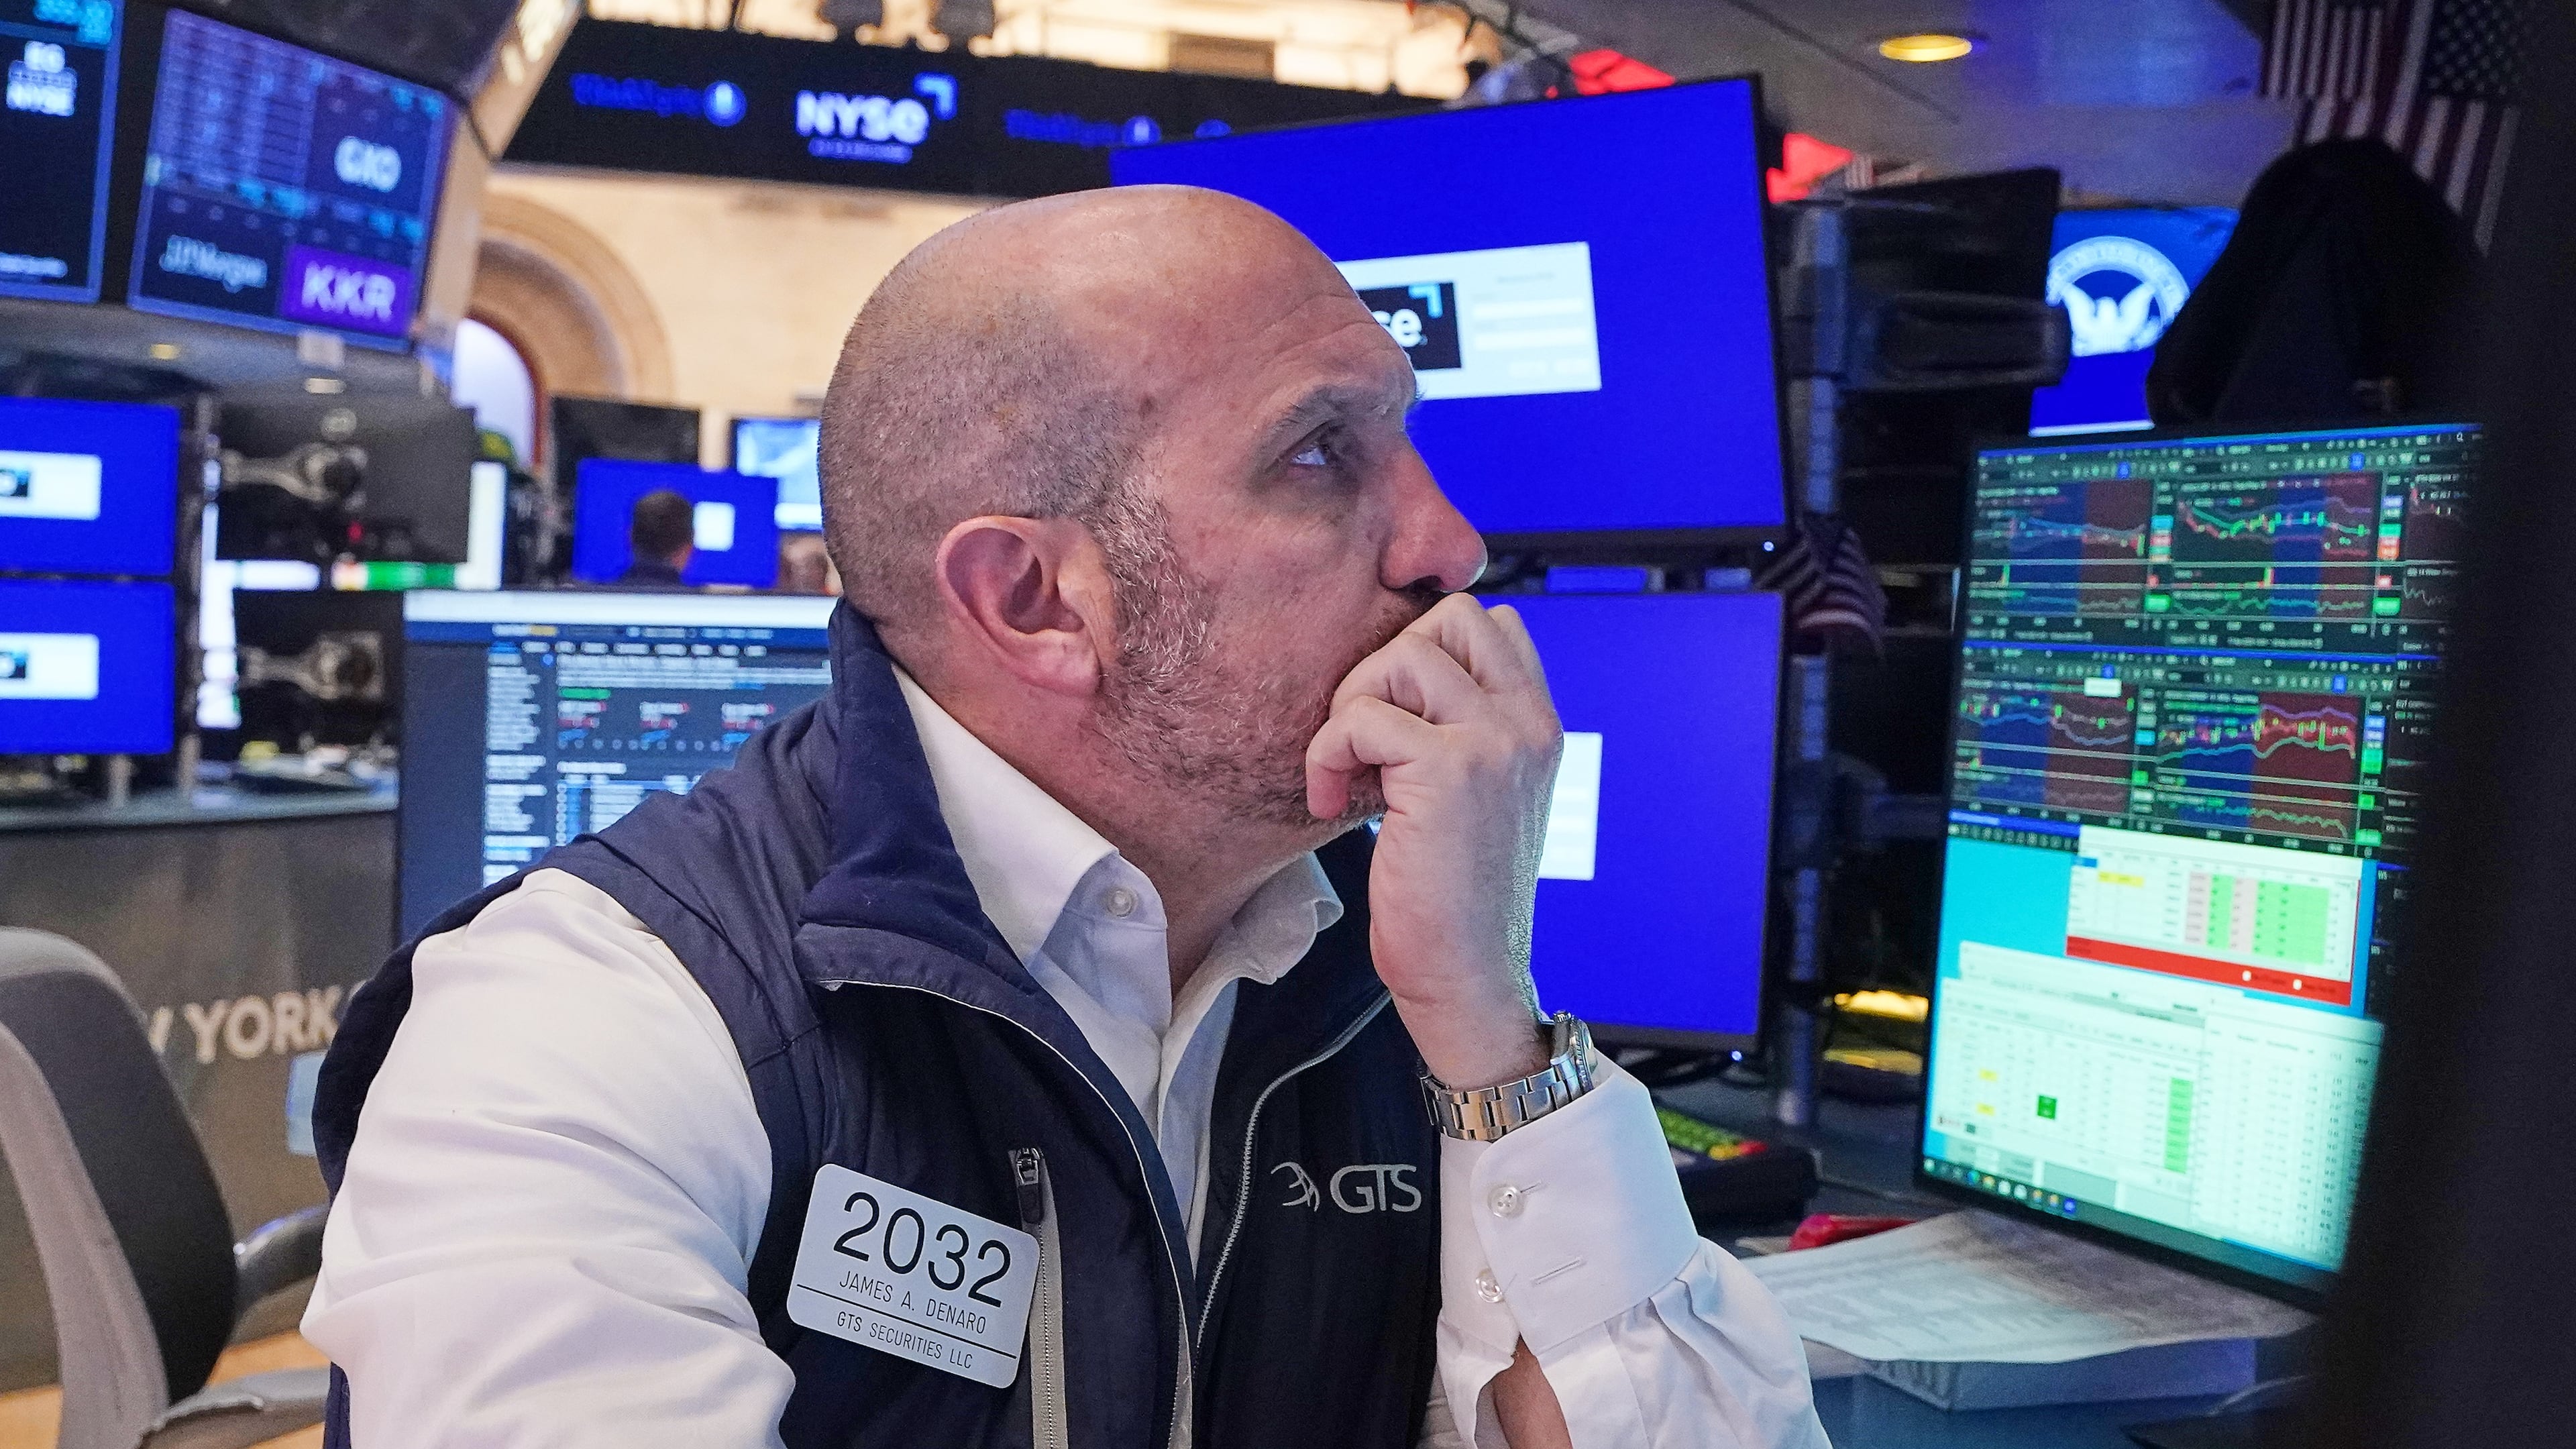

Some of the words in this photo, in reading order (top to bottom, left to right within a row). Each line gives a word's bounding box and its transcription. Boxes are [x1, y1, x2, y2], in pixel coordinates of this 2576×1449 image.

[303, 260, 396, 321] KKR
[184, 985, 341, 1063] YORK
[1330, 1164, 1421, 1214] GTS
[833, 1192, 1011, 1307] 2032
[840, 1271, 893, 1303] JAMES
[902, 1291, 914, 1311] A.
[926, 1299, 985, 1334] DENARO
[837, 1311, 862, 1332] GTS
[870, 1323, 942, 1358] SECURITIES
[950, 1350, 973, 1368] LLC
